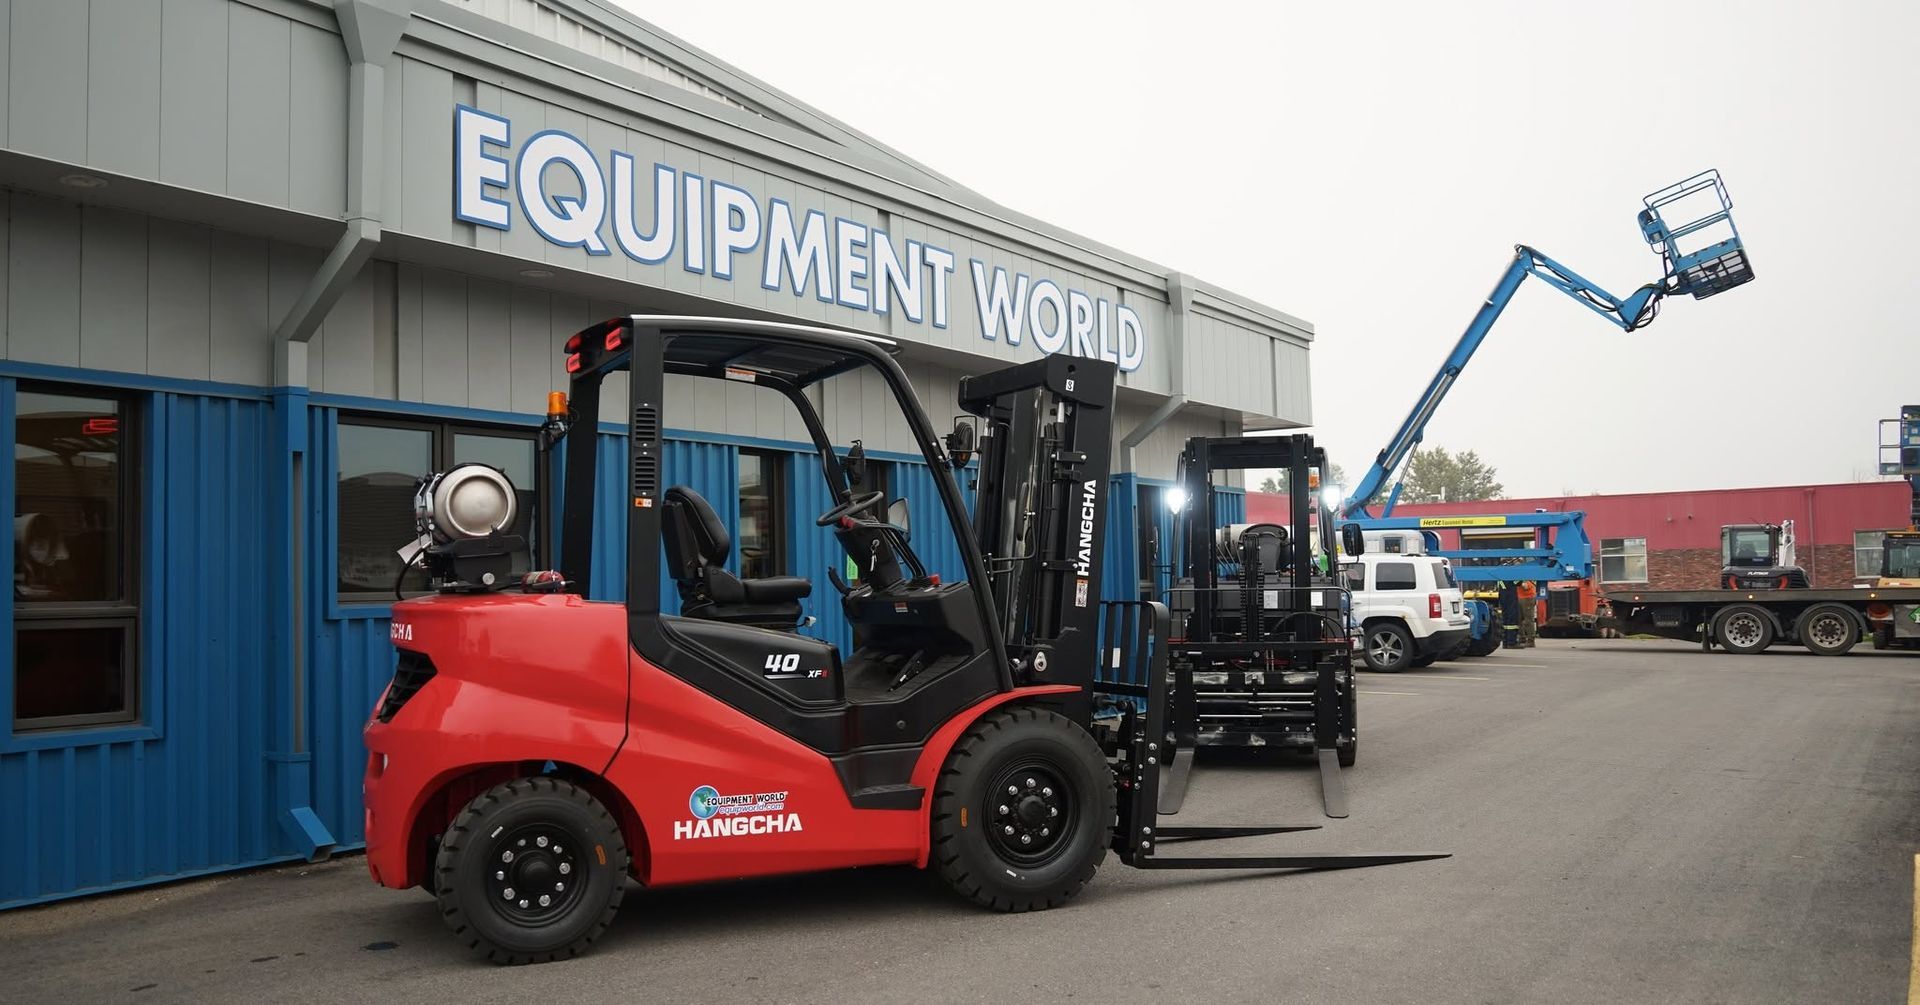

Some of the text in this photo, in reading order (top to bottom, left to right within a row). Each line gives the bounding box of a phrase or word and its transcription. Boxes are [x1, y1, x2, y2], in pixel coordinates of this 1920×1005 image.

[456, 103, 1145, 373] EQUIPMENT WORLD
[1077, 480, 1097, 576] HANGCHA
[765, 654, 800, 672] 40
[706, 792, 785, 806] EQUIPMENT WORLD
[719, 802, 785, 815] equipworld.com
[674, 813, 803, 840] HANGCHA
